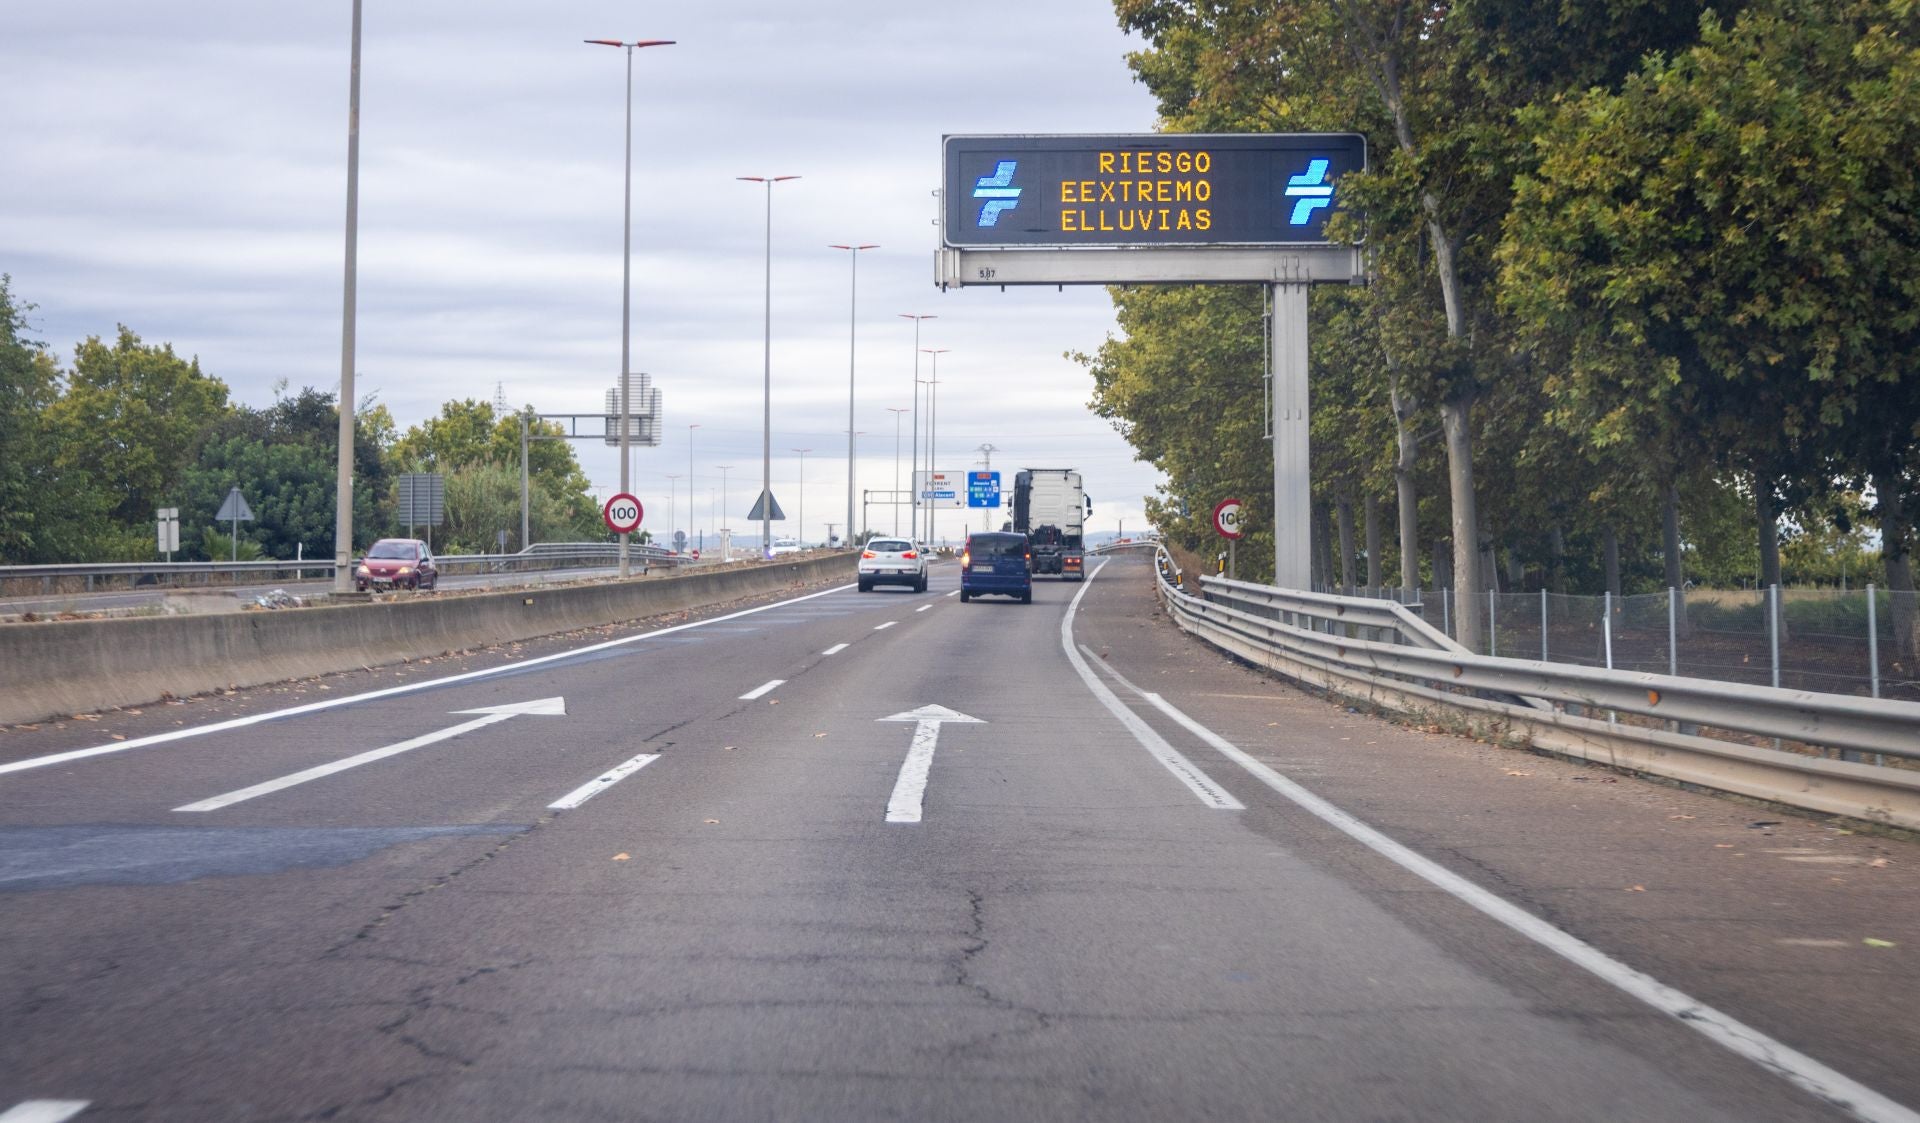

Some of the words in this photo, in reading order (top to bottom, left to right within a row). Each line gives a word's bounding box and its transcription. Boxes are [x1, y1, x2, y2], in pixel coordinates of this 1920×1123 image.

[1099, 151, 1211, 173] RIESGO
[1061, 180, 1211, 202] EEXTREMO
[1061, 209, 1211, 231] ELLUVIAS
[611, 507, 637, 520] 100
